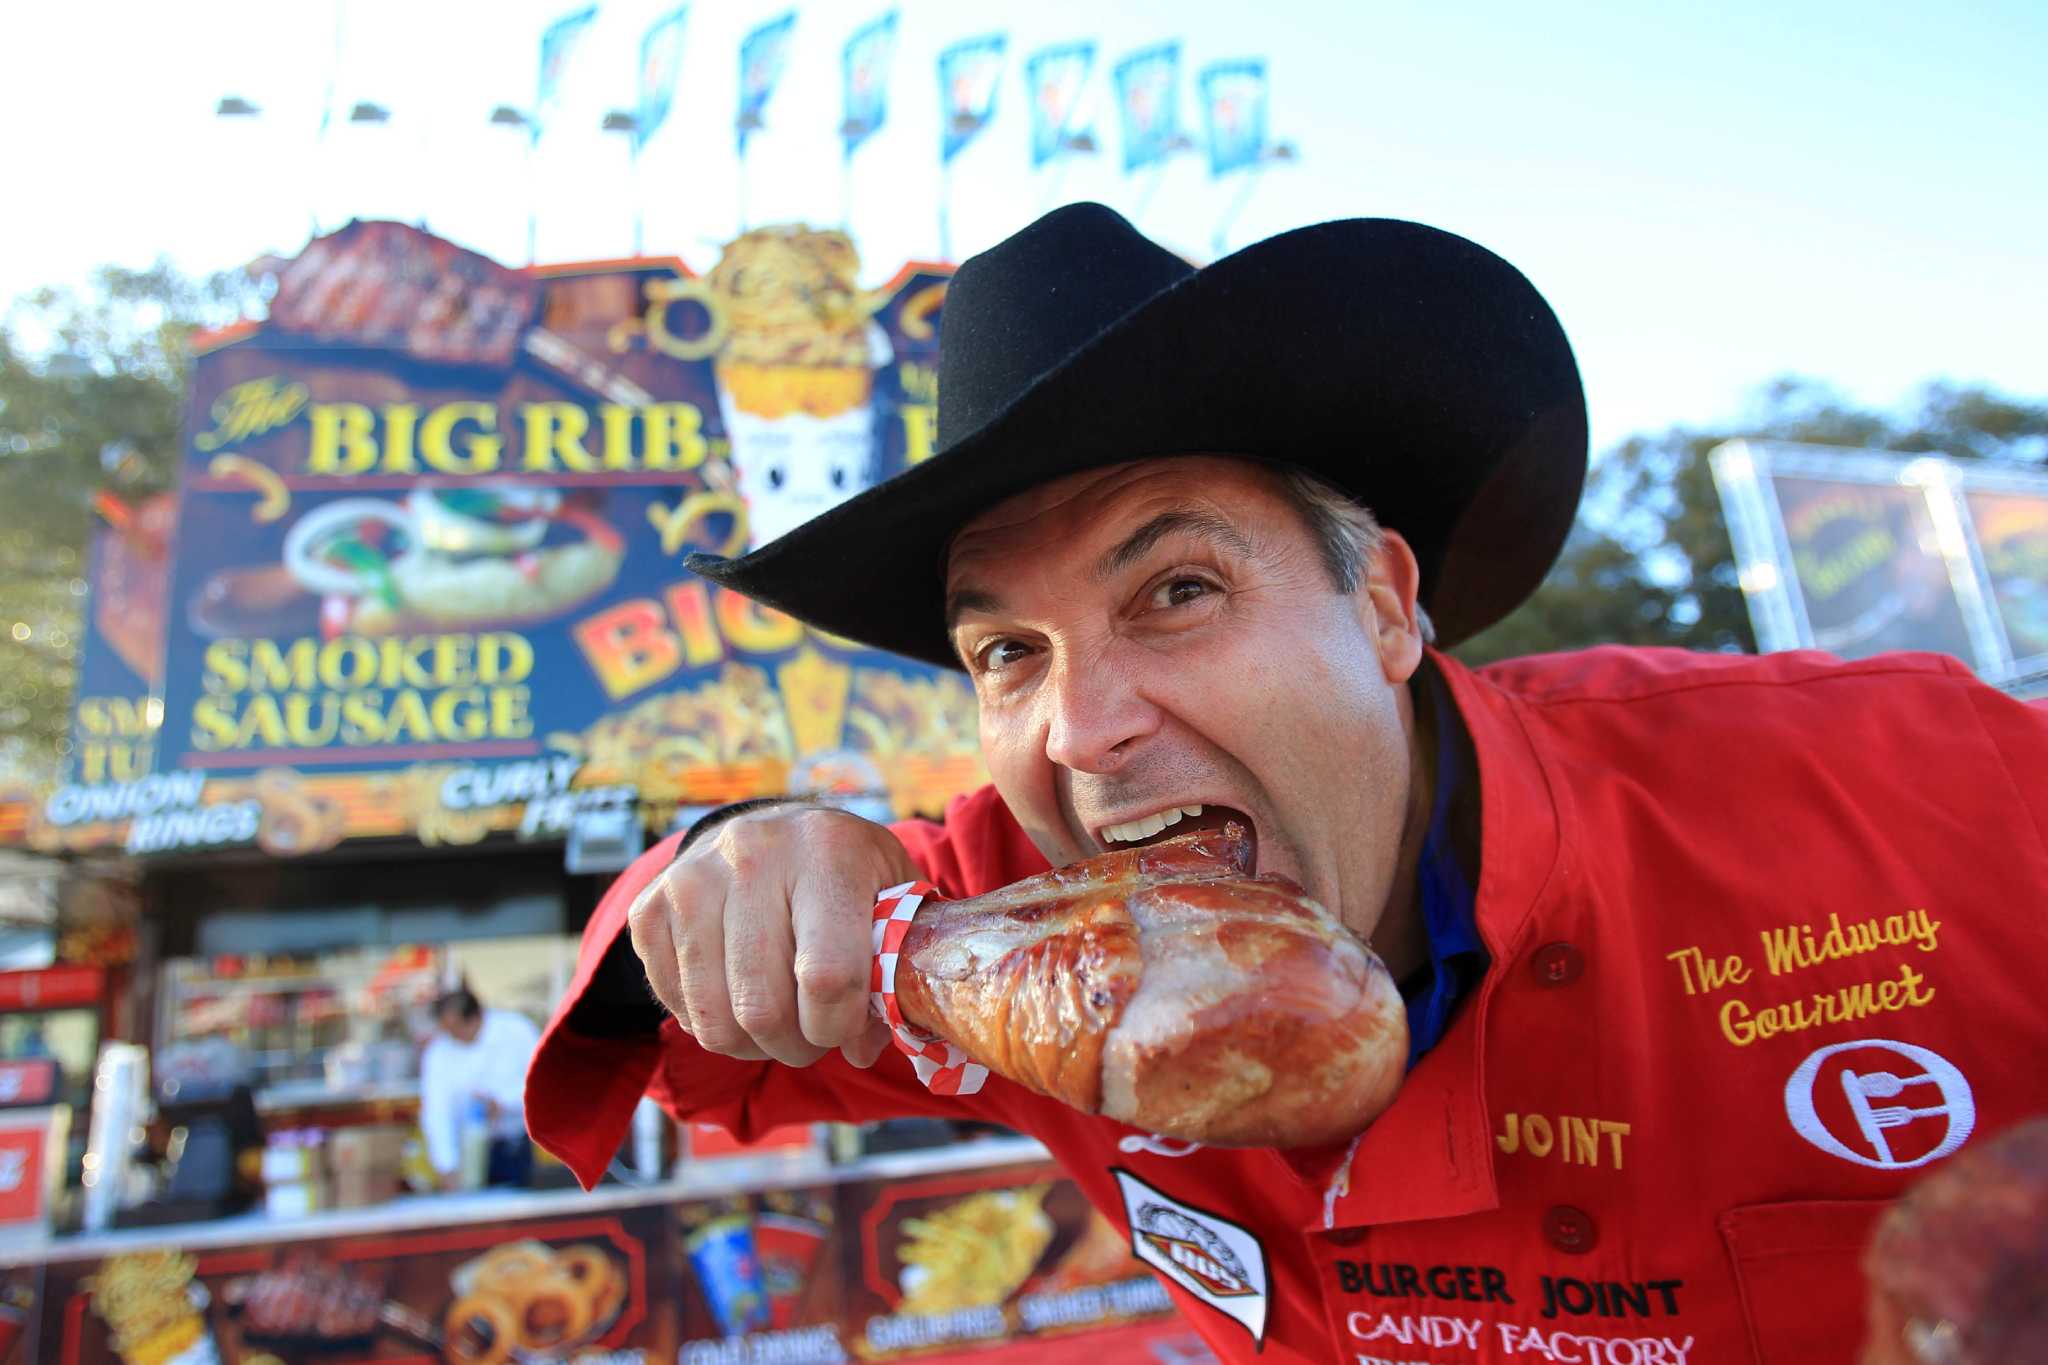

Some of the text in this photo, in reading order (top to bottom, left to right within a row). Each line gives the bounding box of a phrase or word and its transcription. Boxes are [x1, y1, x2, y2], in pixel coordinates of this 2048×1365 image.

[308, 402, 500, 475] BIG
[523, 401, 708, 473] RIB
[202, 632, 535, 695] SMOKED
[572, 578, 868, 700] BIG
[191, 684, 535, 752] SAUSAGE
[46, 766, 206, 825] ONION
[441, 754, 581, 809] CURLY
[125, 799, 262, 855] RINGS
[1666, 908, 1942, 995] The Midway
[1719, 963, 1936, 1046] Gourmet
[1496, 1112, 1632, 1170] JOINT
[1335, 1259, 1684, 1319] BURGER JOINT
[1347, 1311, 1695, 1365] CANDY FACTORY
